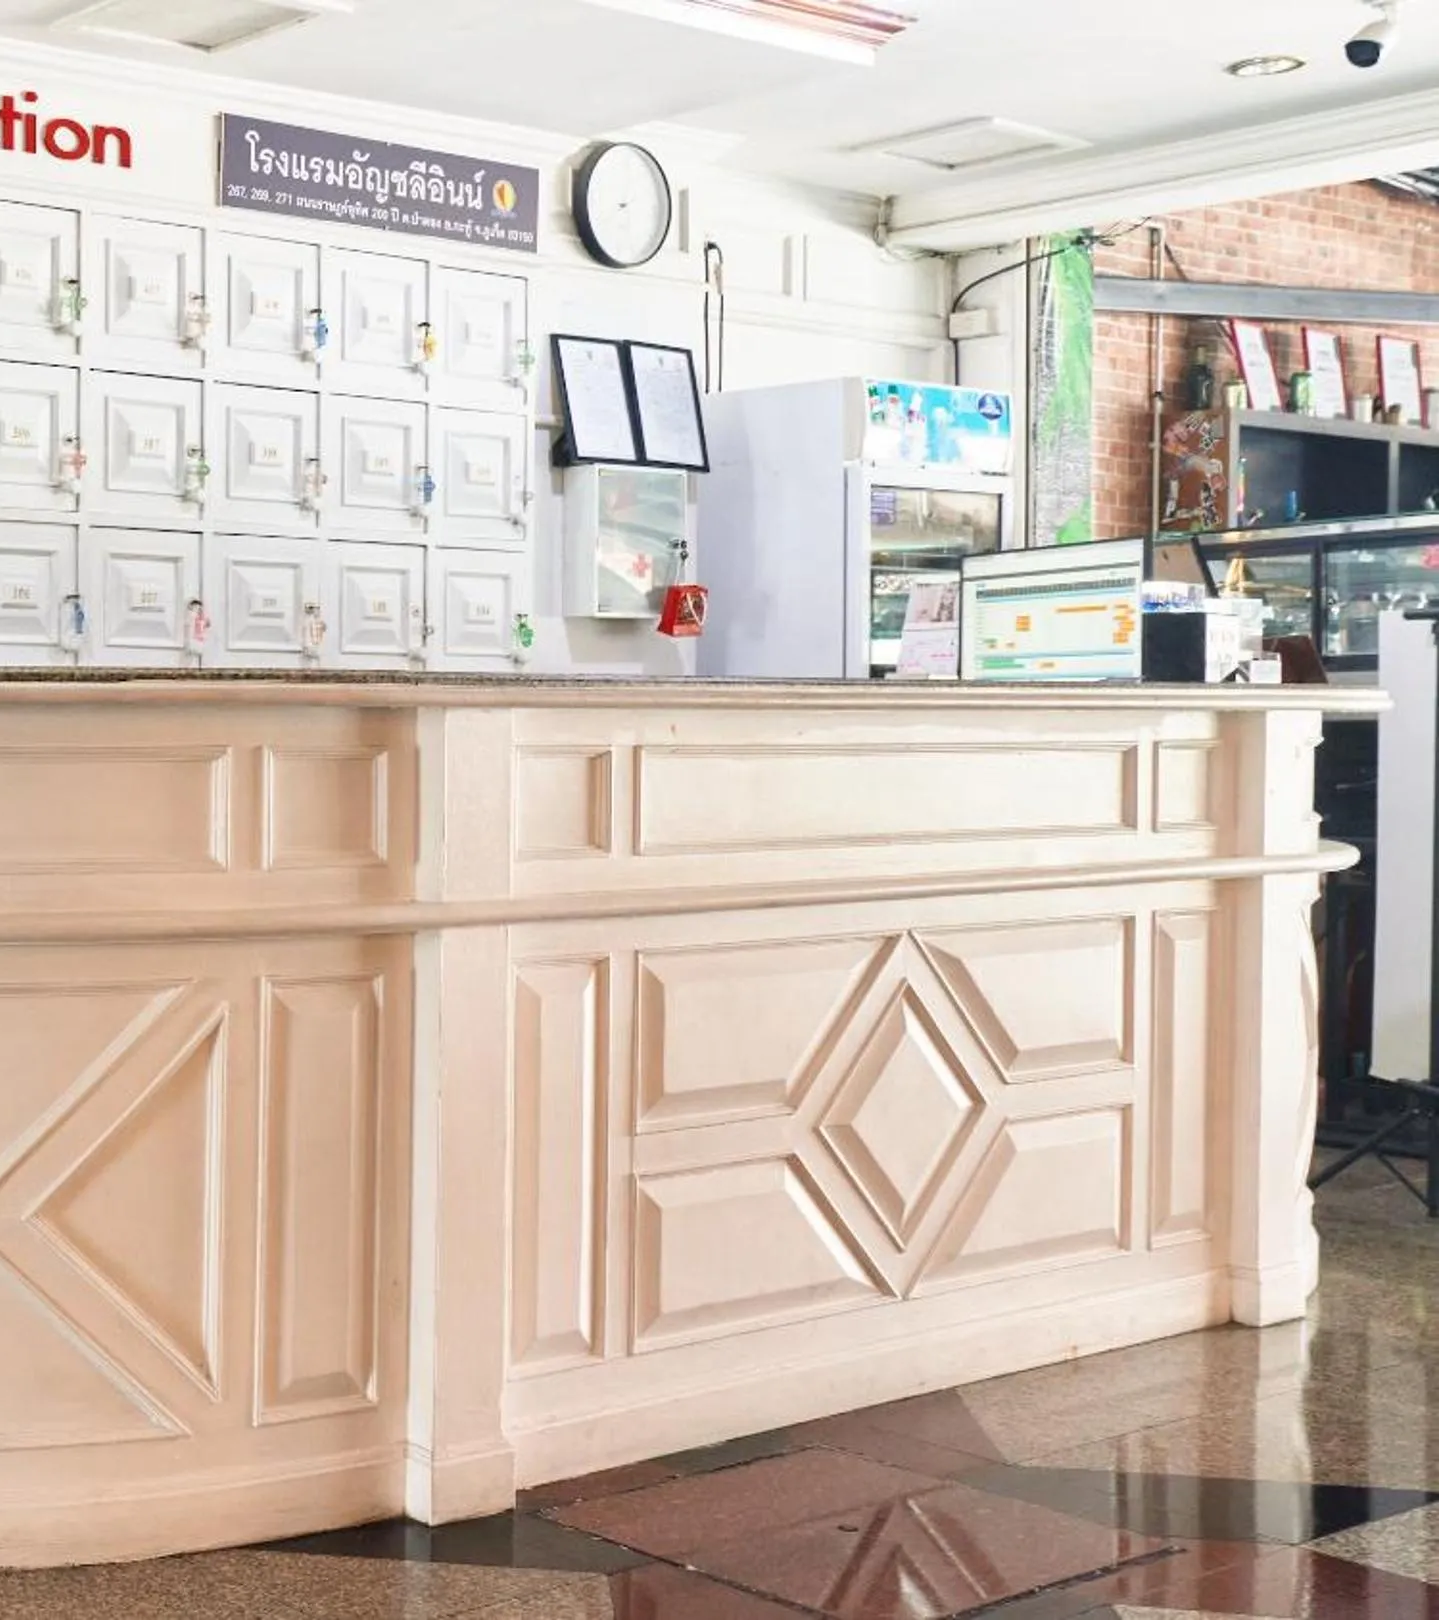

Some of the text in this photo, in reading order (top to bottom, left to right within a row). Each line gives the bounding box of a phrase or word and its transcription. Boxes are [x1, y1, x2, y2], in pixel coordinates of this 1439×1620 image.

[245, 130, 485, 210] โรงแรมอัญชลีอินน์
[275, 191, 293, 205] 271
